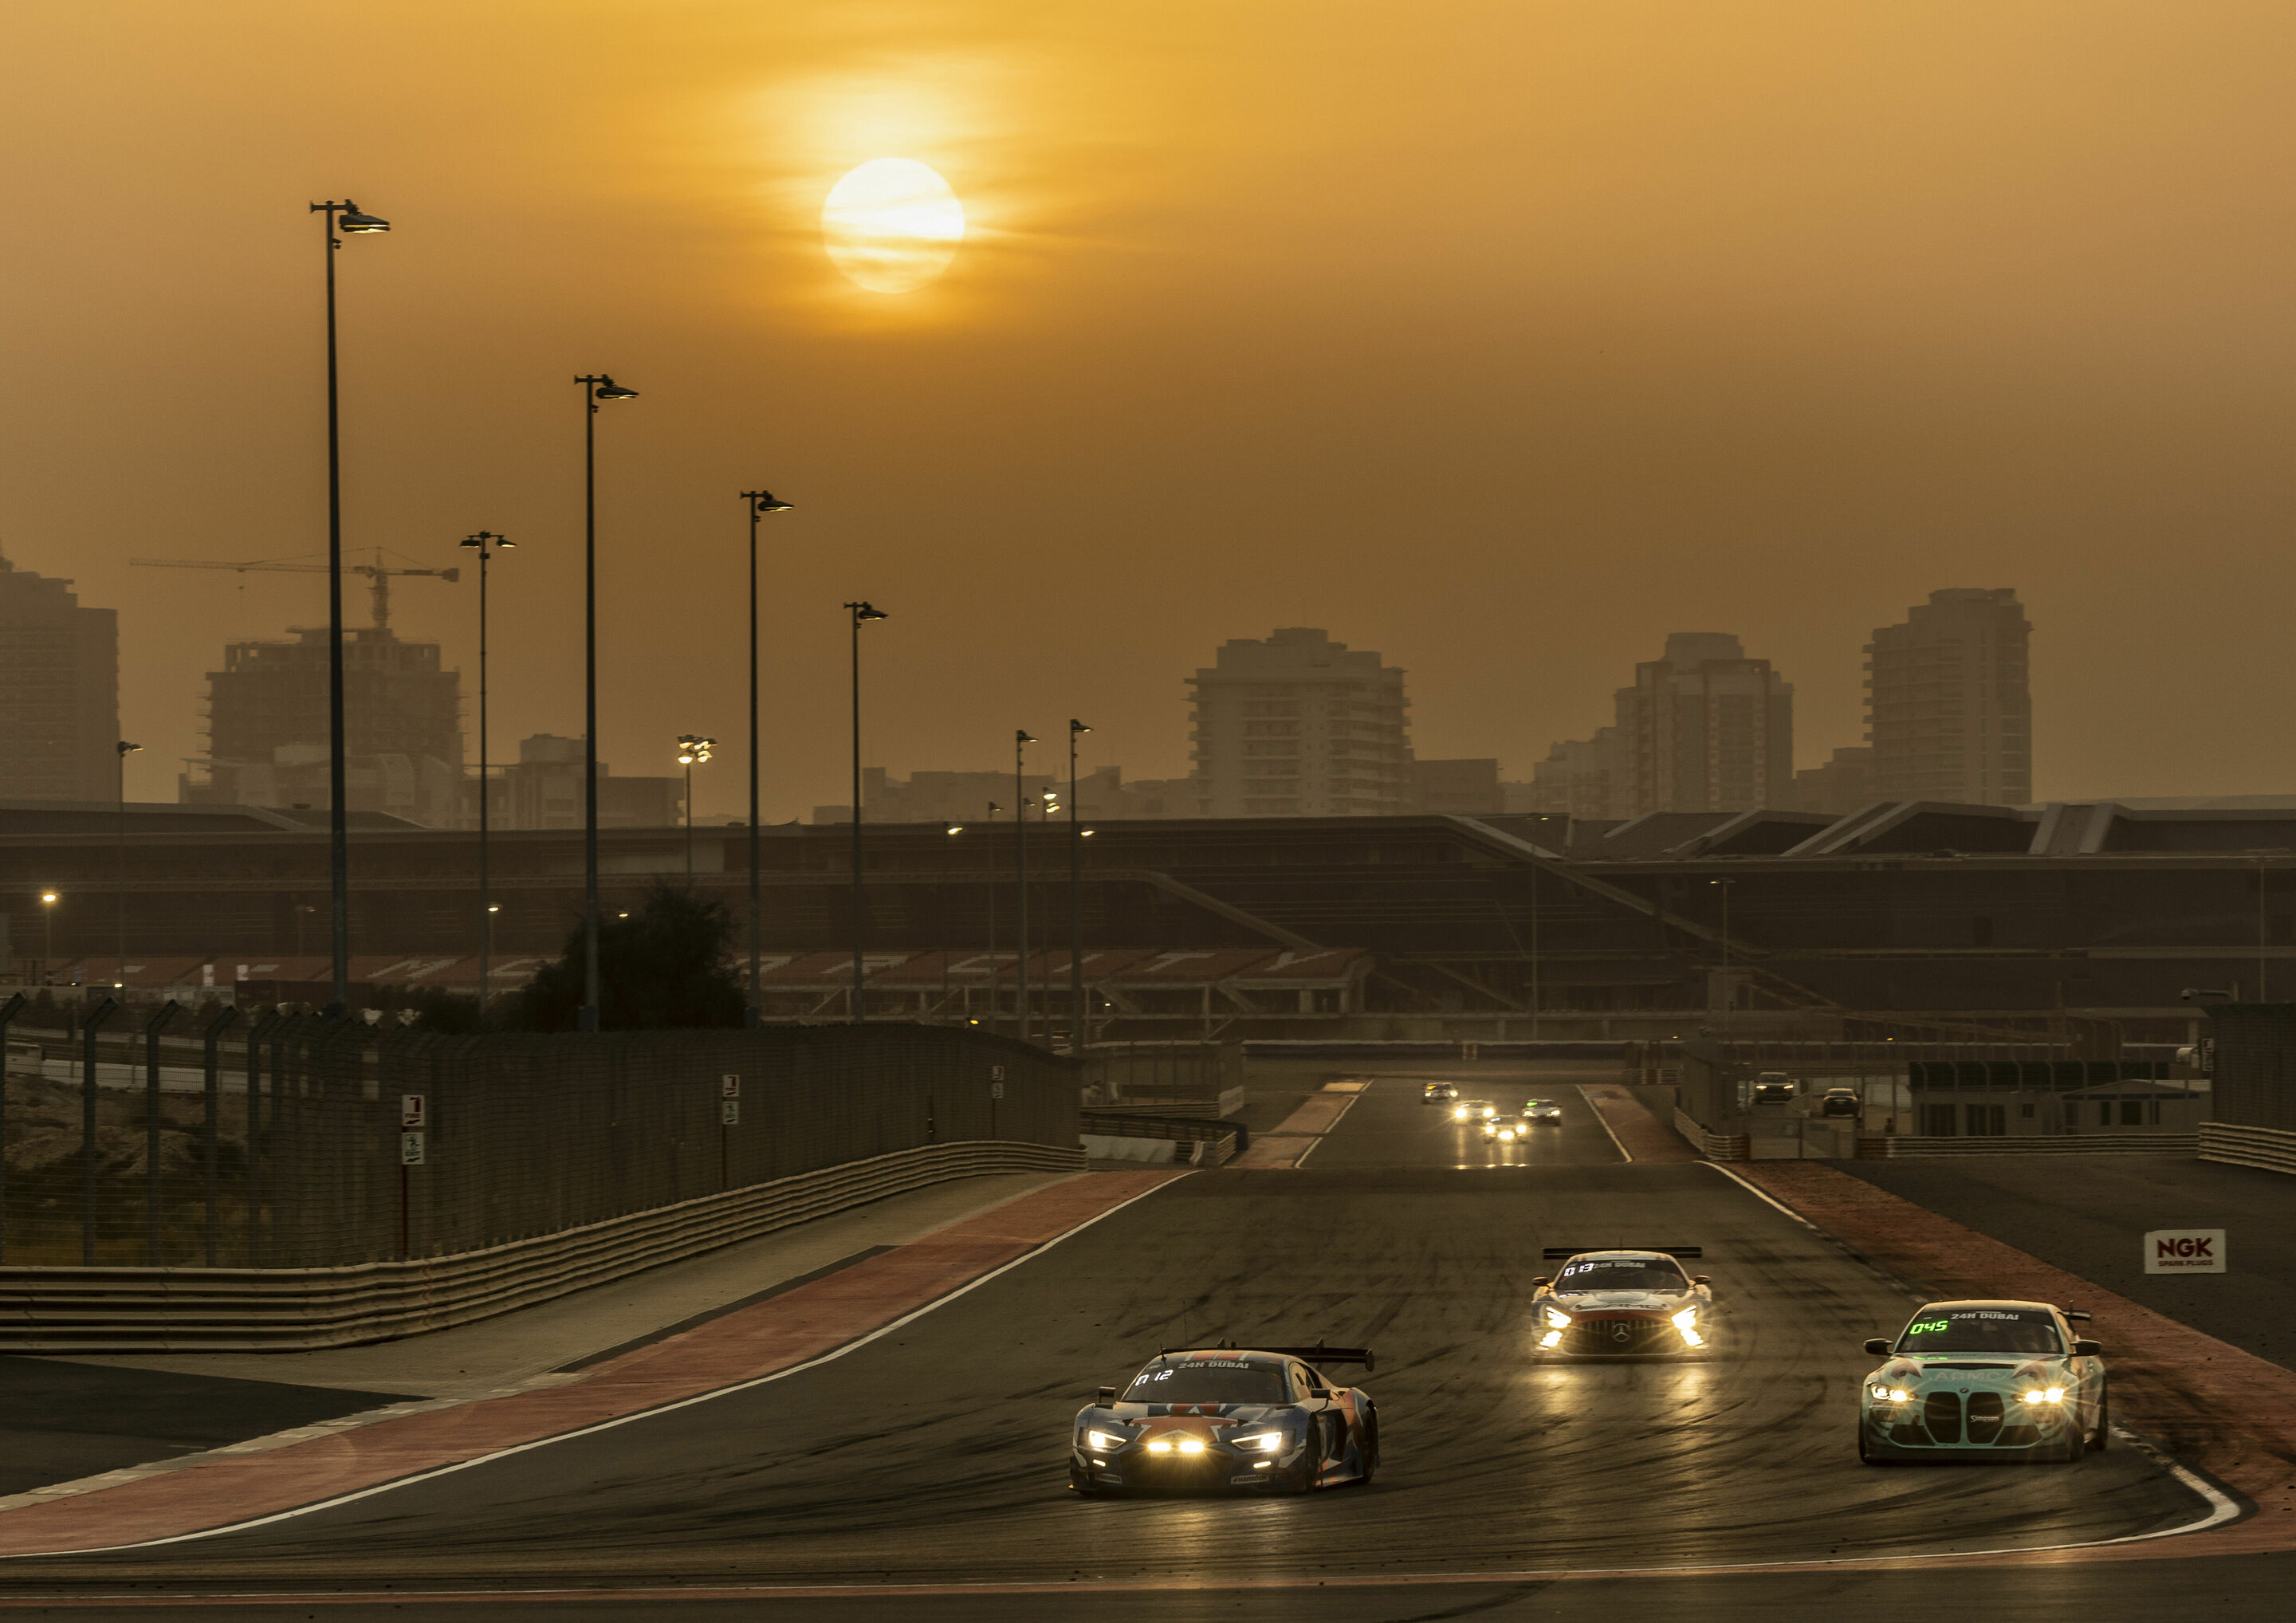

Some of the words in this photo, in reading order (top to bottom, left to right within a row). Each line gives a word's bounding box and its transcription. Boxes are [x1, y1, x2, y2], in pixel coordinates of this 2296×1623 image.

[2157, 1238, 2213, 1258] NGK
[1909, 1320, 1948, 1334] 045
[1933, 1371, 2001, 1382] AGMC
